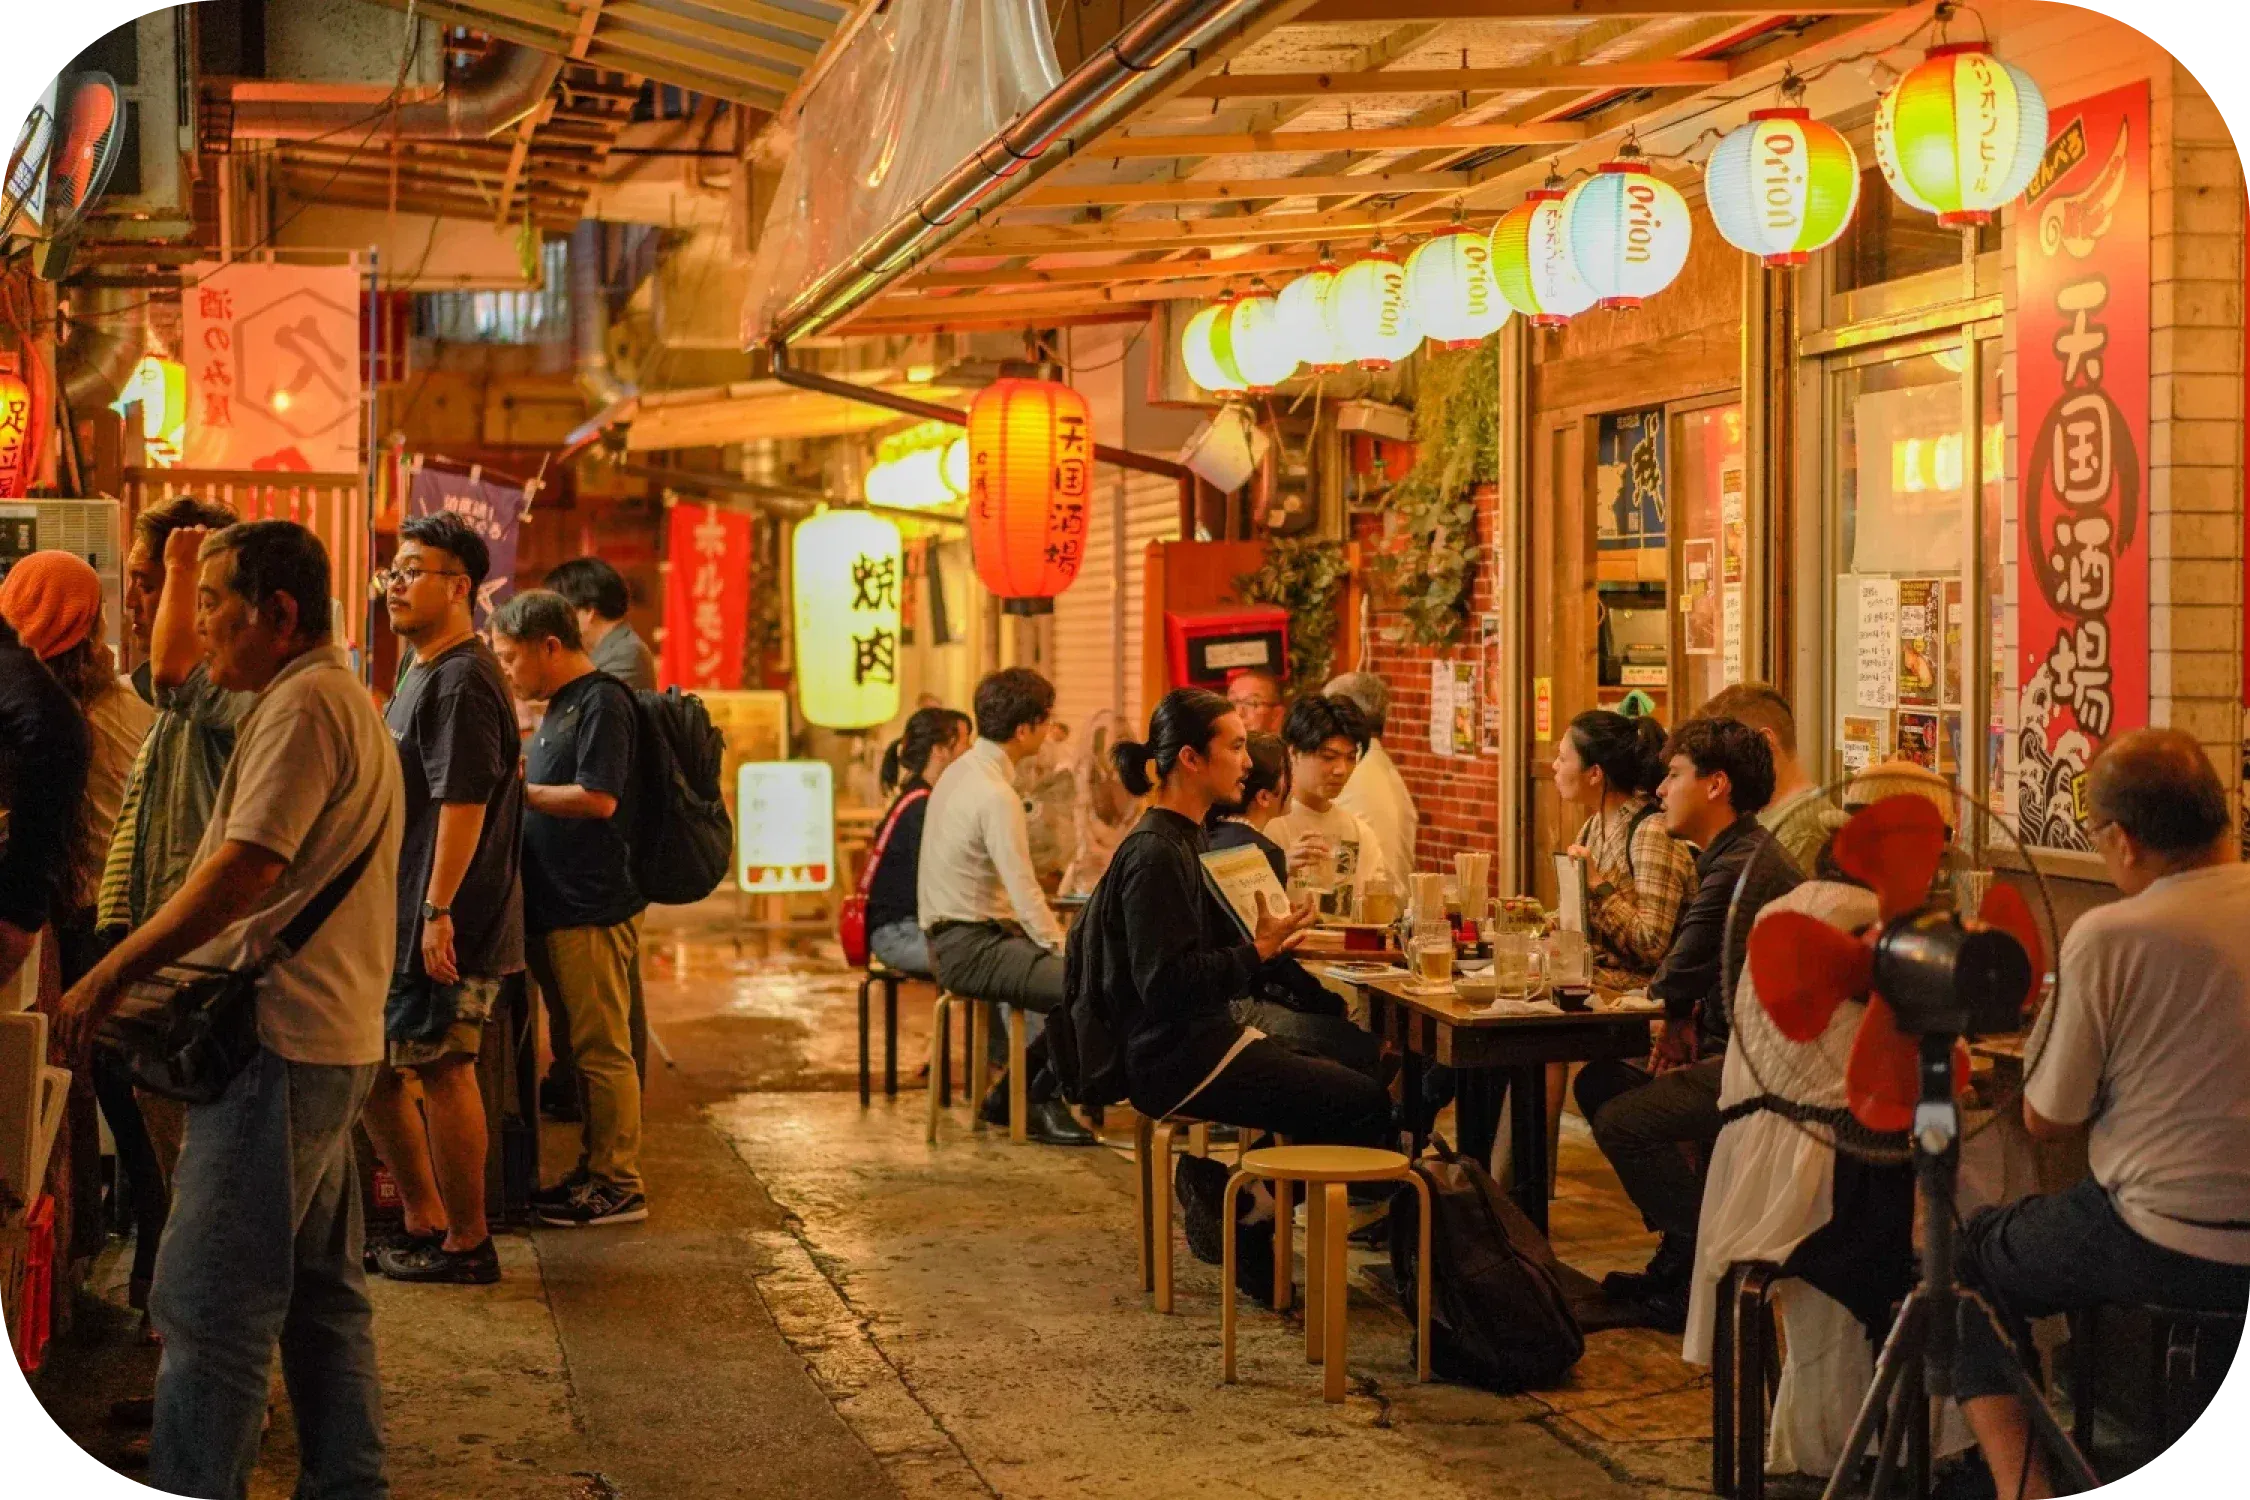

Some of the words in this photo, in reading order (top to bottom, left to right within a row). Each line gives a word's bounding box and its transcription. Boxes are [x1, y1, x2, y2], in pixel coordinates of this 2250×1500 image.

[1626, 185, 1662, 263] Orion
[1764, 134, 1802, 228] Orion
[1044, 416, 1085, 577] 天国酒場
[2046, 279, 2111, 736] 天国酒場
[852, 552, 896, 686] 焼肉
